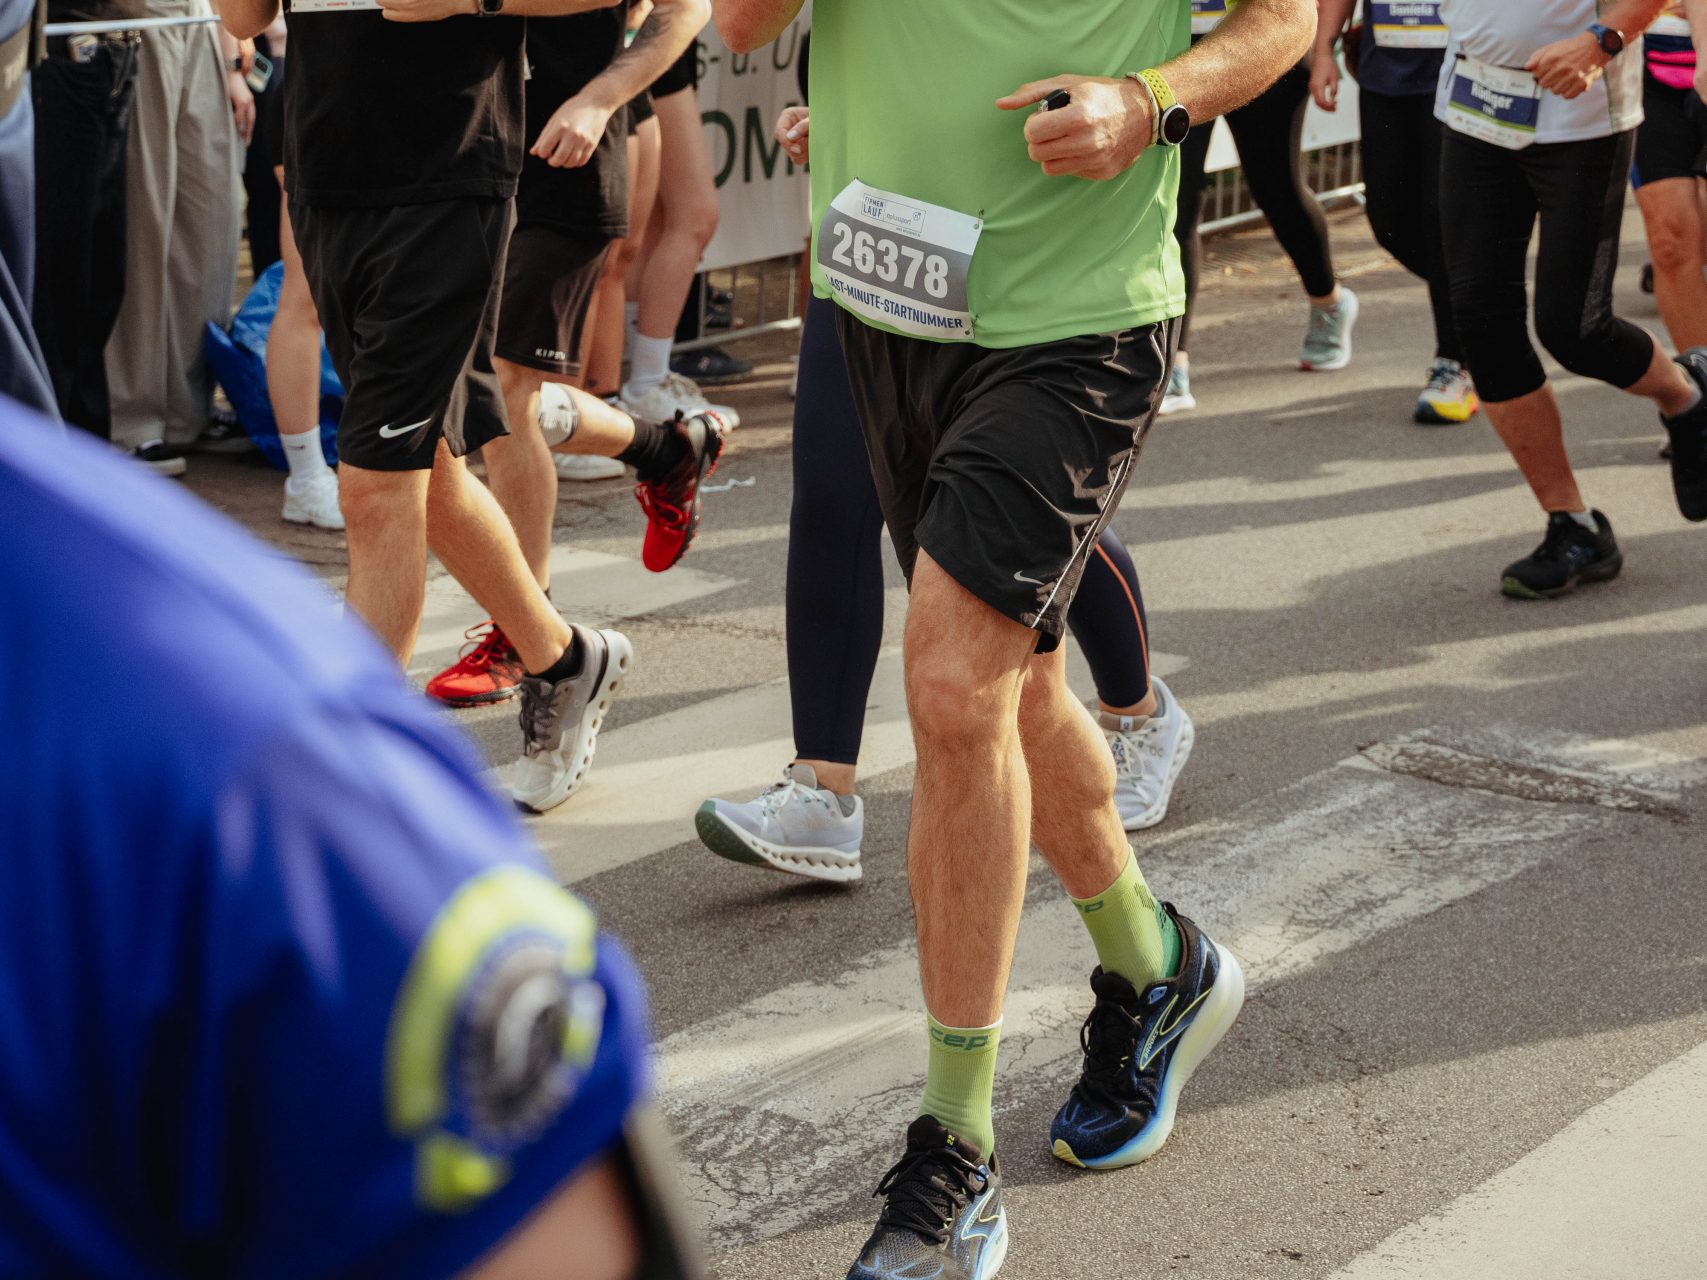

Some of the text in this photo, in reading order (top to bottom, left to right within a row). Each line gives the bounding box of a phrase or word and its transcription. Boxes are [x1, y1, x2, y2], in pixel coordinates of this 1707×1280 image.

[863, 204, 883, 218] LAUF
[864, 196, 885, 208] FIRMEN
[831, 221, 949, 299] 26378
[931, 1027, 989, 1051] cep
